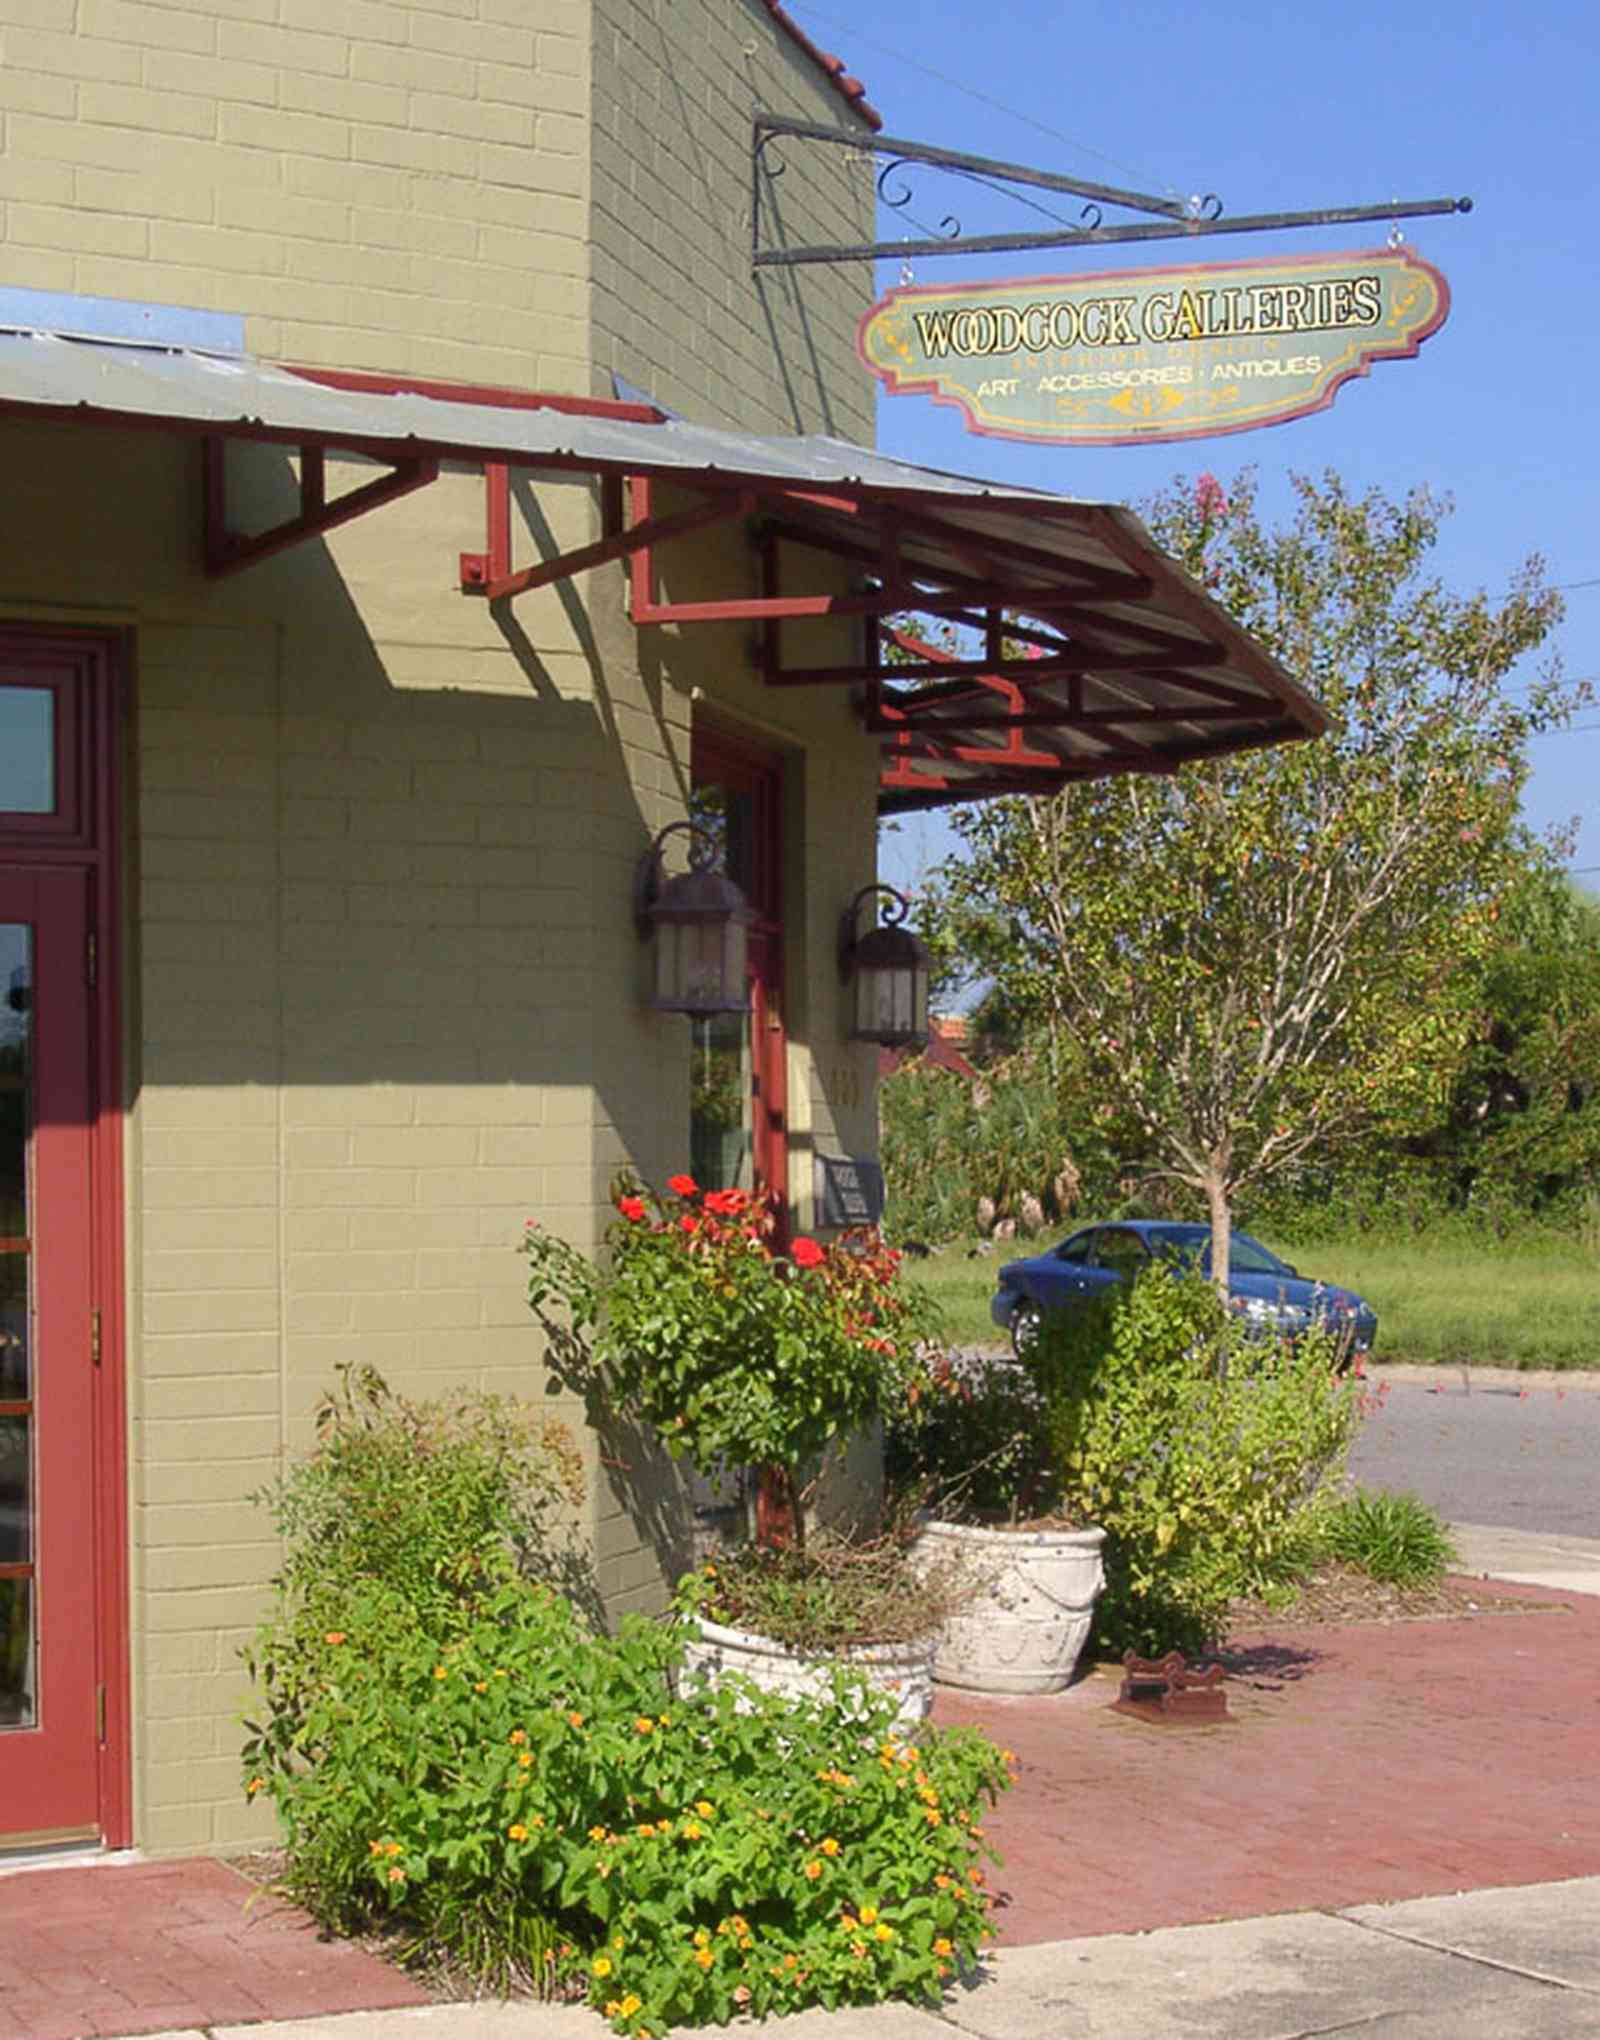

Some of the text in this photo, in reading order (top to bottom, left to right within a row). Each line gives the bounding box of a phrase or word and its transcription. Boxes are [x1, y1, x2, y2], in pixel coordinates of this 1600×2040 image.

[913, 297, 1141, 358] WOODCOCK
[1142, 276, 1382, 343] GALLERIES
[977, 355, 1322, 398] ART ACCESSORIES ANTIQUES
